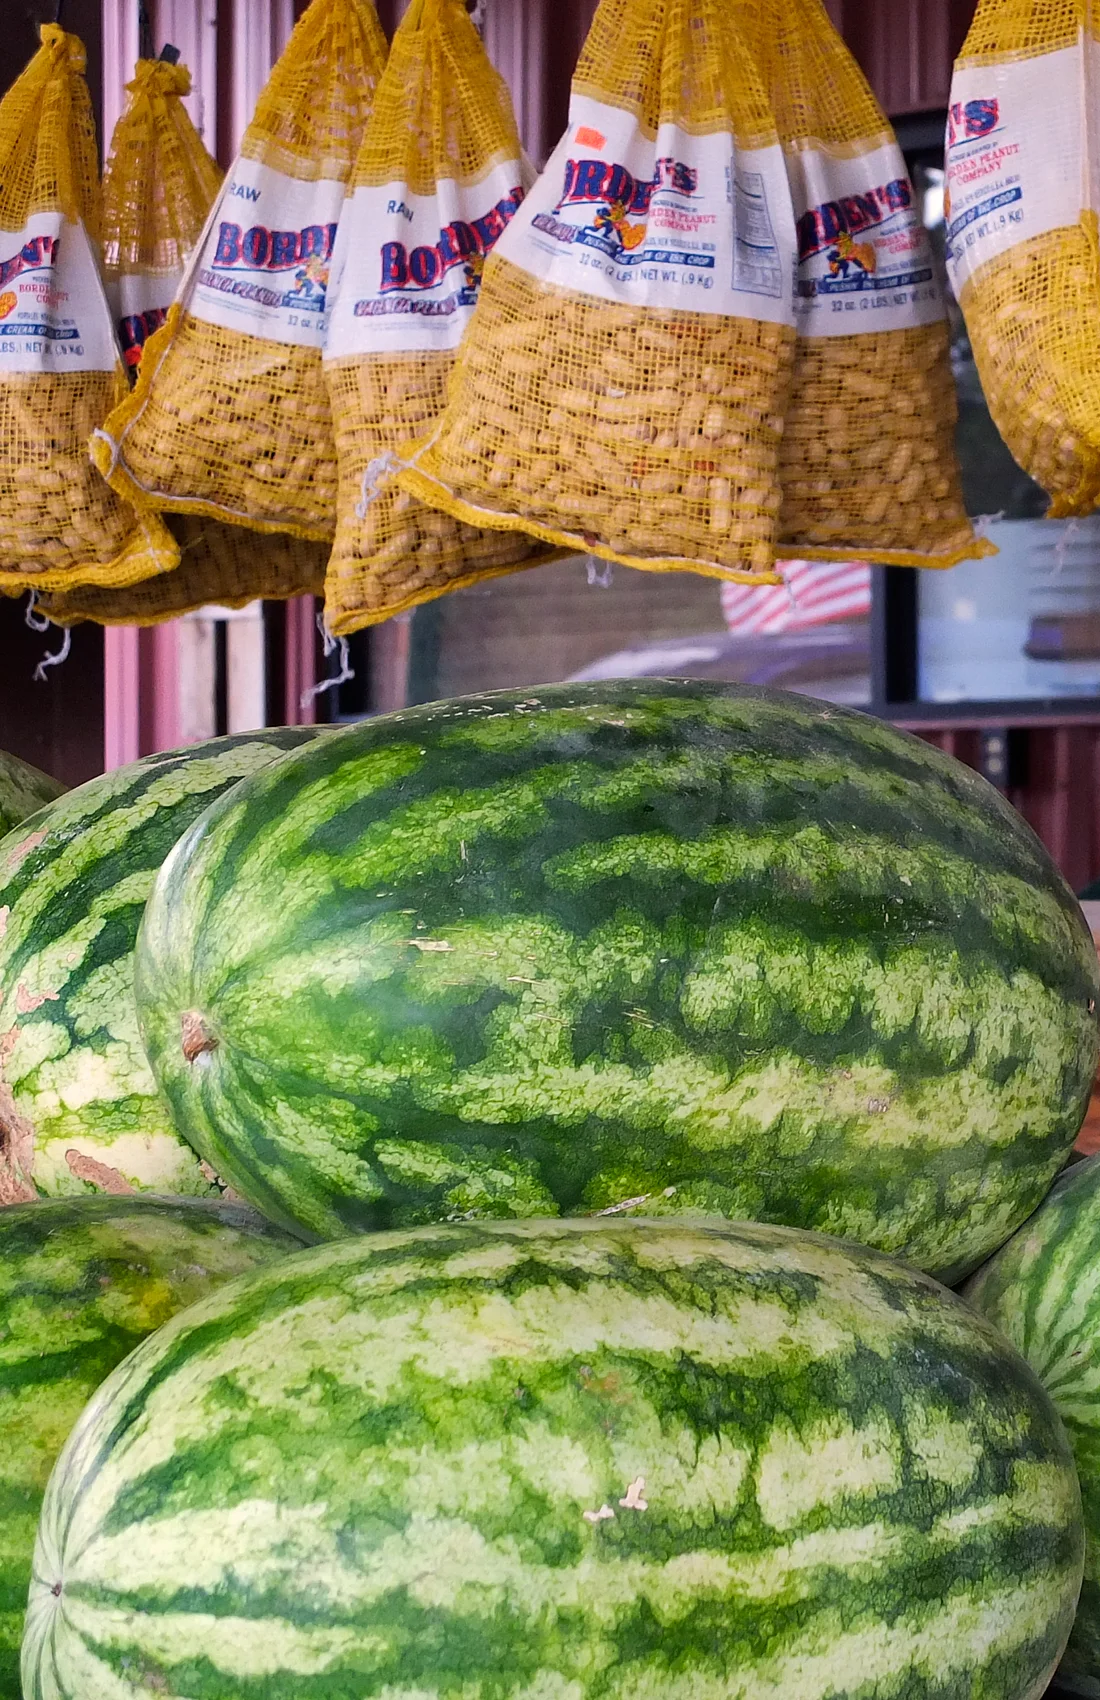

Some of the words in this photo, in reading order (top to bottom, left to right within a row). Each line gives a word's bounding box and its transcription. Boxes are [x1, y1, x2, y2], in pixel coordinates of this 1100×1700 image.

[980, 143, 1019, 164] PEANUT
[957, 161, 1002, 186] COMPANY
[654, 219, 699, 232] COMPANY
[678, 211, 717, 223] PEANUT
